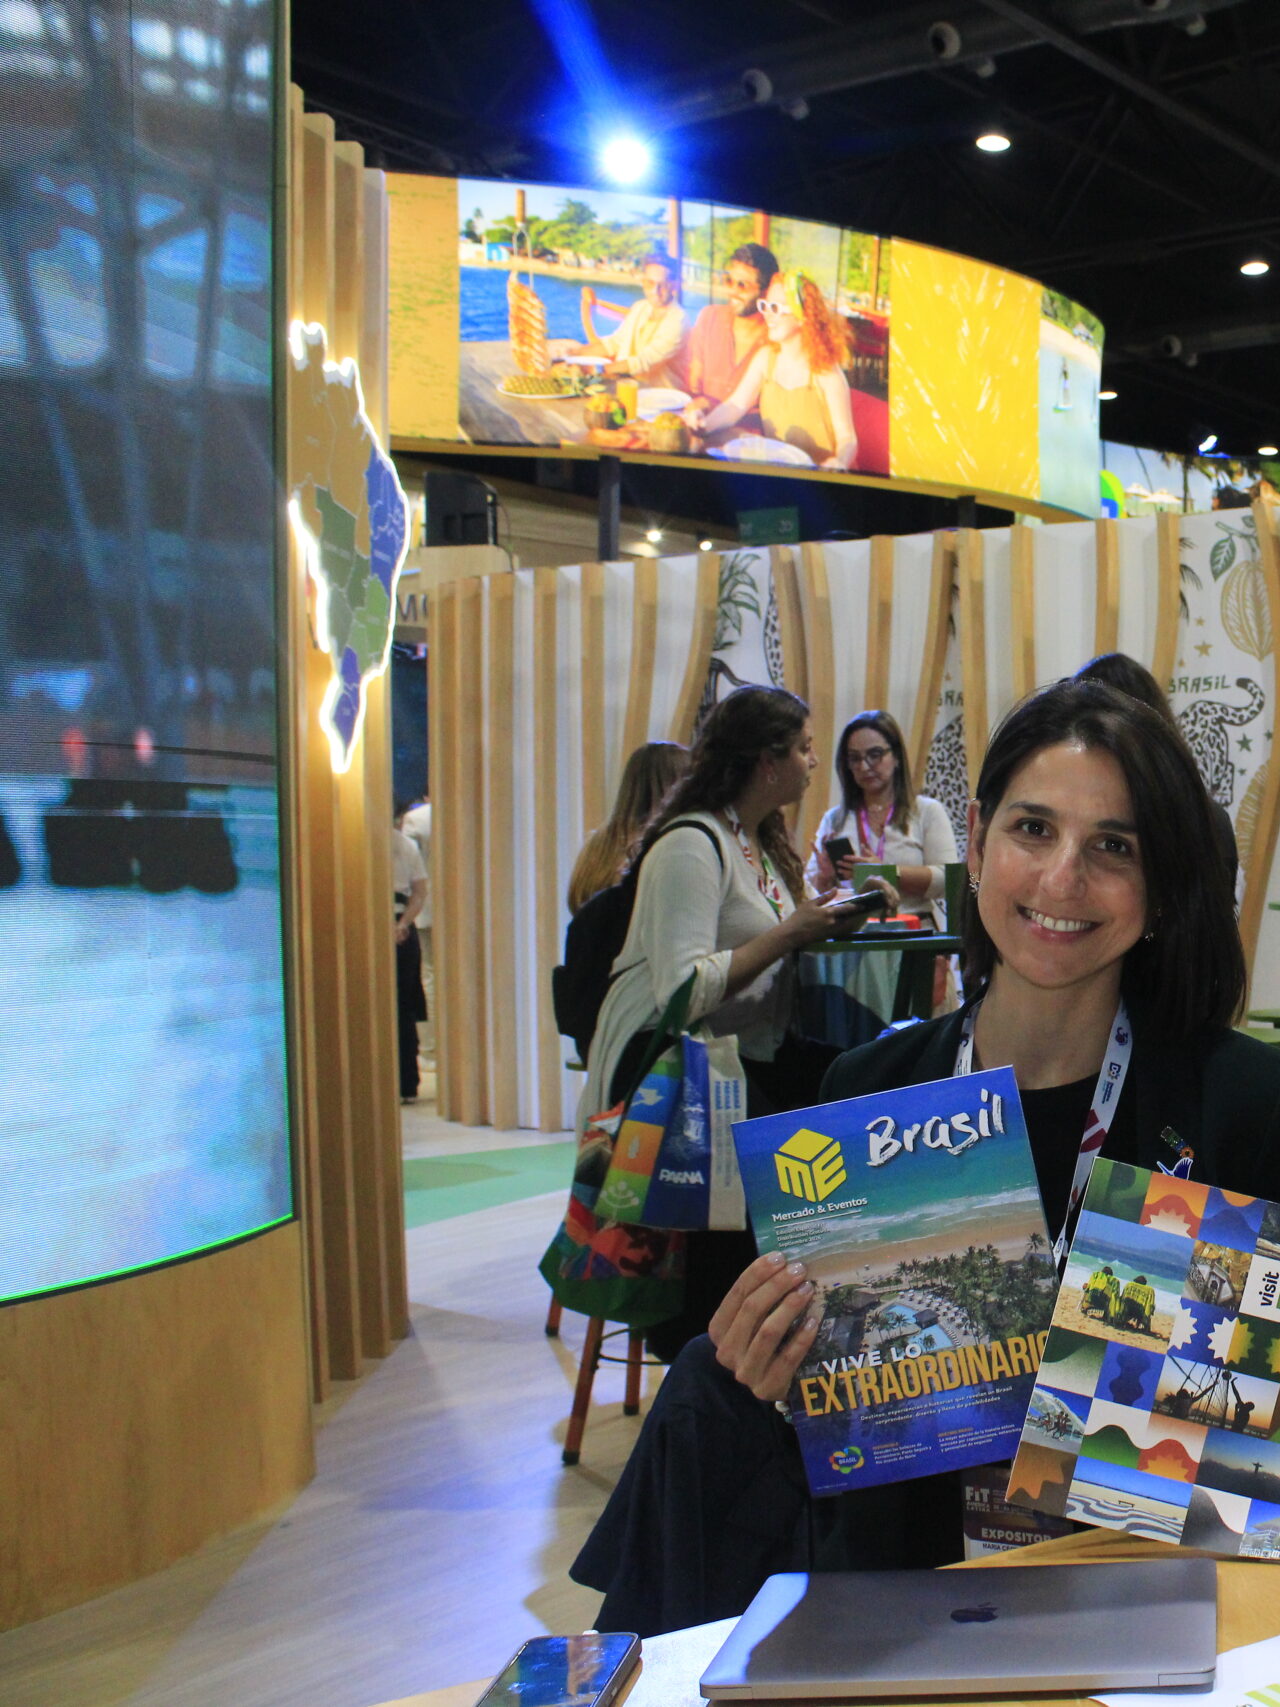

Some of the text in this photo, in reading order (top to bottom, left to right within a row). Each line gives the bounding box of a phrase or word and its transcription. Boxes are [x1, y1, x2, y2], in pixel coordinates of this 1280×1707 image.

[865, 1088, 1006, 1167] Brasil
[772, 1195, 868, 1223] Mercado & Eventos
[1258, 1271, 1280, 1307] visit
[821, 1343, 923, 1375] VIVE LO
